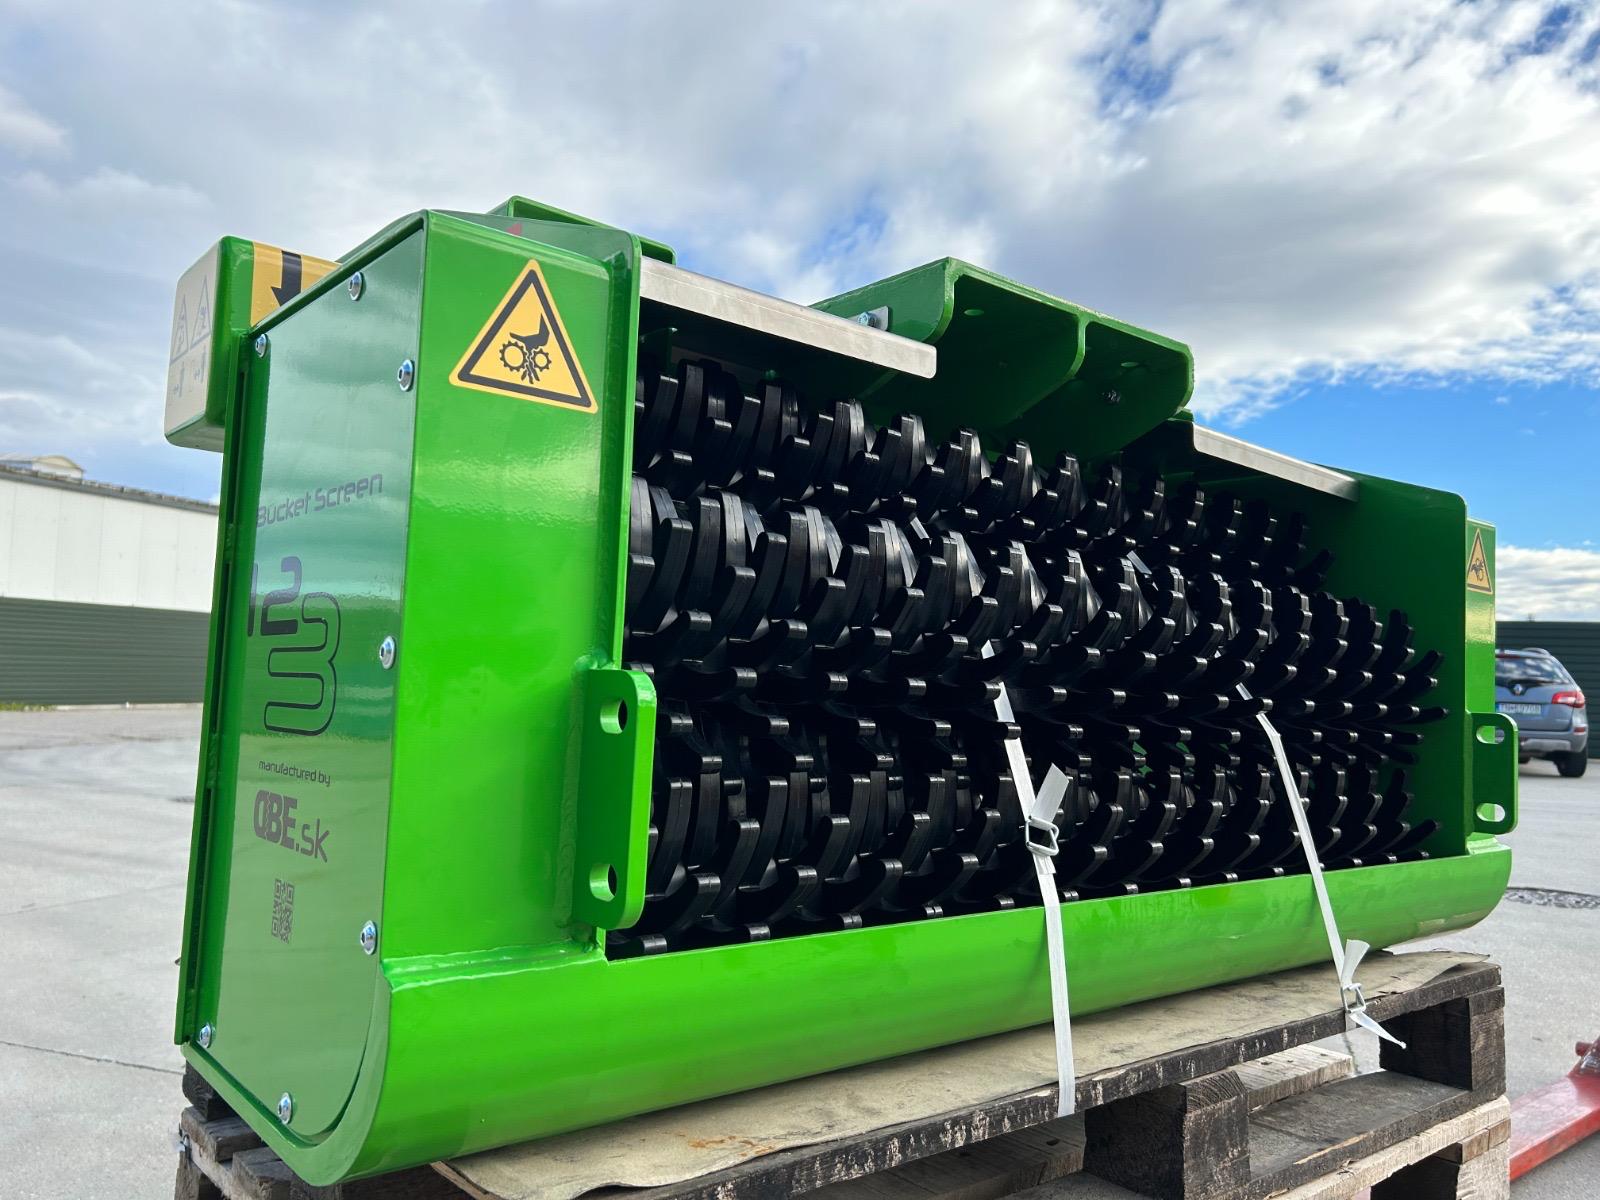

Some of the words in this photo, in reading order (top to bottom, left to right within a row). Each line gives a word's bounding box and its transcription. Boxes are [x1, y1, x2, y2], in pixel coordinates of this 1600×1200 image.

[256, 491, 311, 528] Bucket
[313, 473, 383, 512] Screen
[258, 760, 317, 782] manufactured
[318, 770, 331, 788] by
